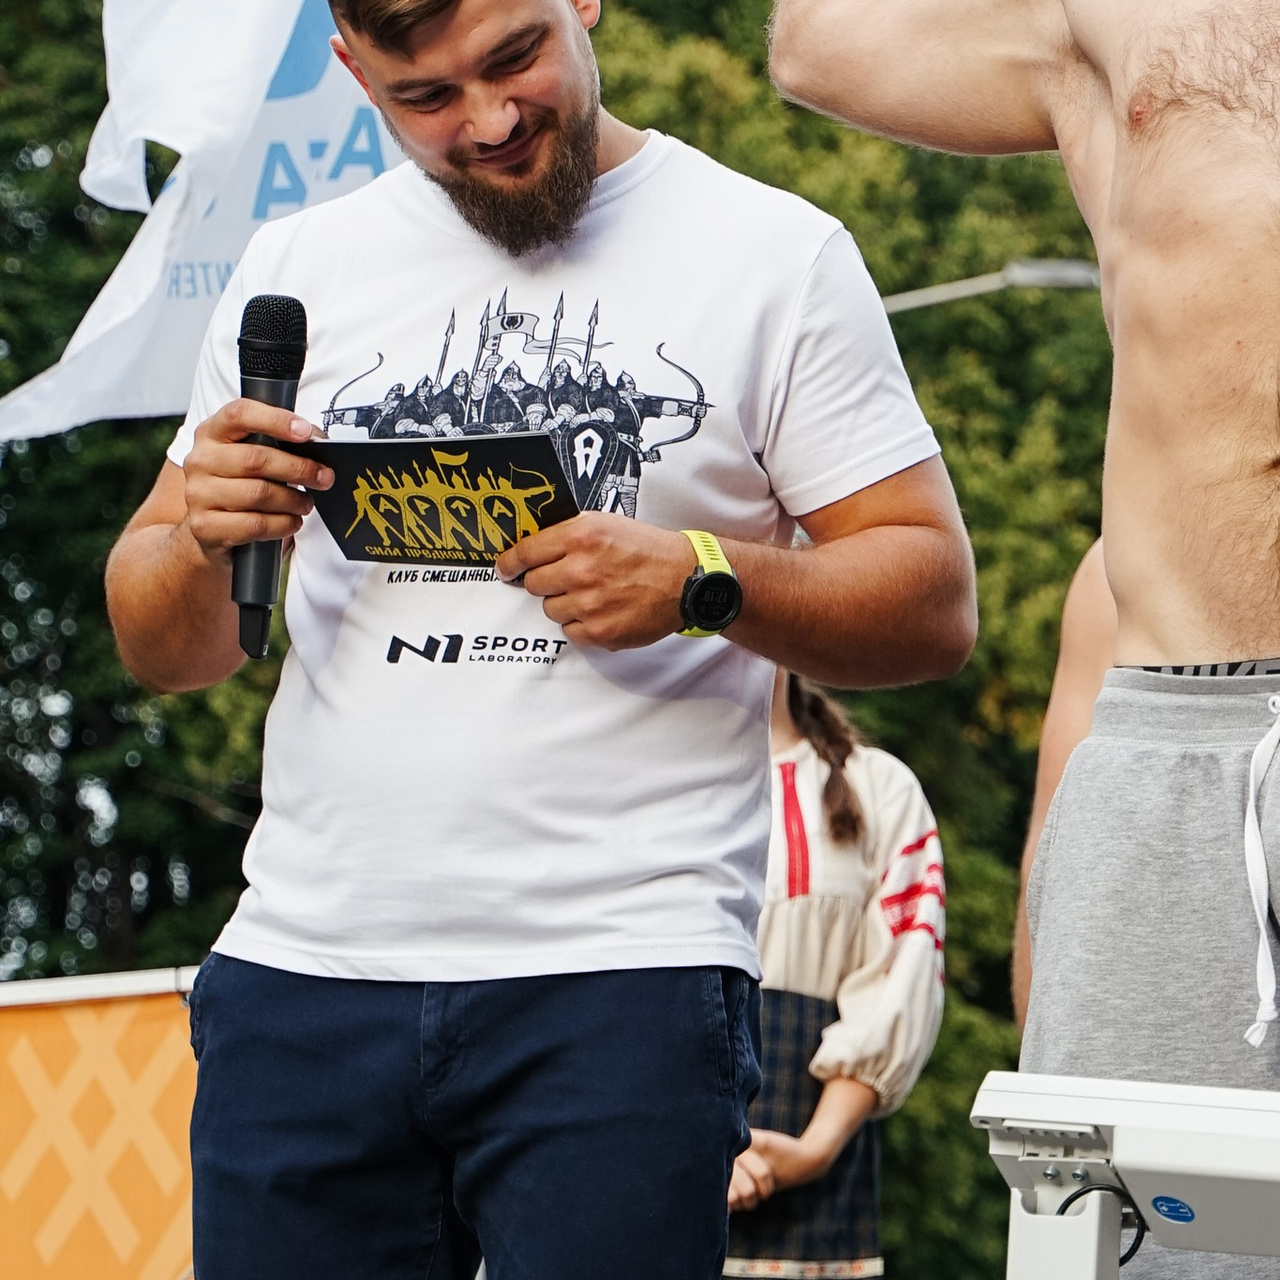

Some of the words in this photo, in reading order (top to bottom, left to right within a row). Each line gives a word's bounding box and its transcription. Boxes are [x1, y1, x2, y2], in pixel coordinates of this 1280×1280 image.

[387, 570, 419, 584] КЛУБ
[472, 636, 568, 654] SPORT
[469, 654, 557, 665] LABORATORY
